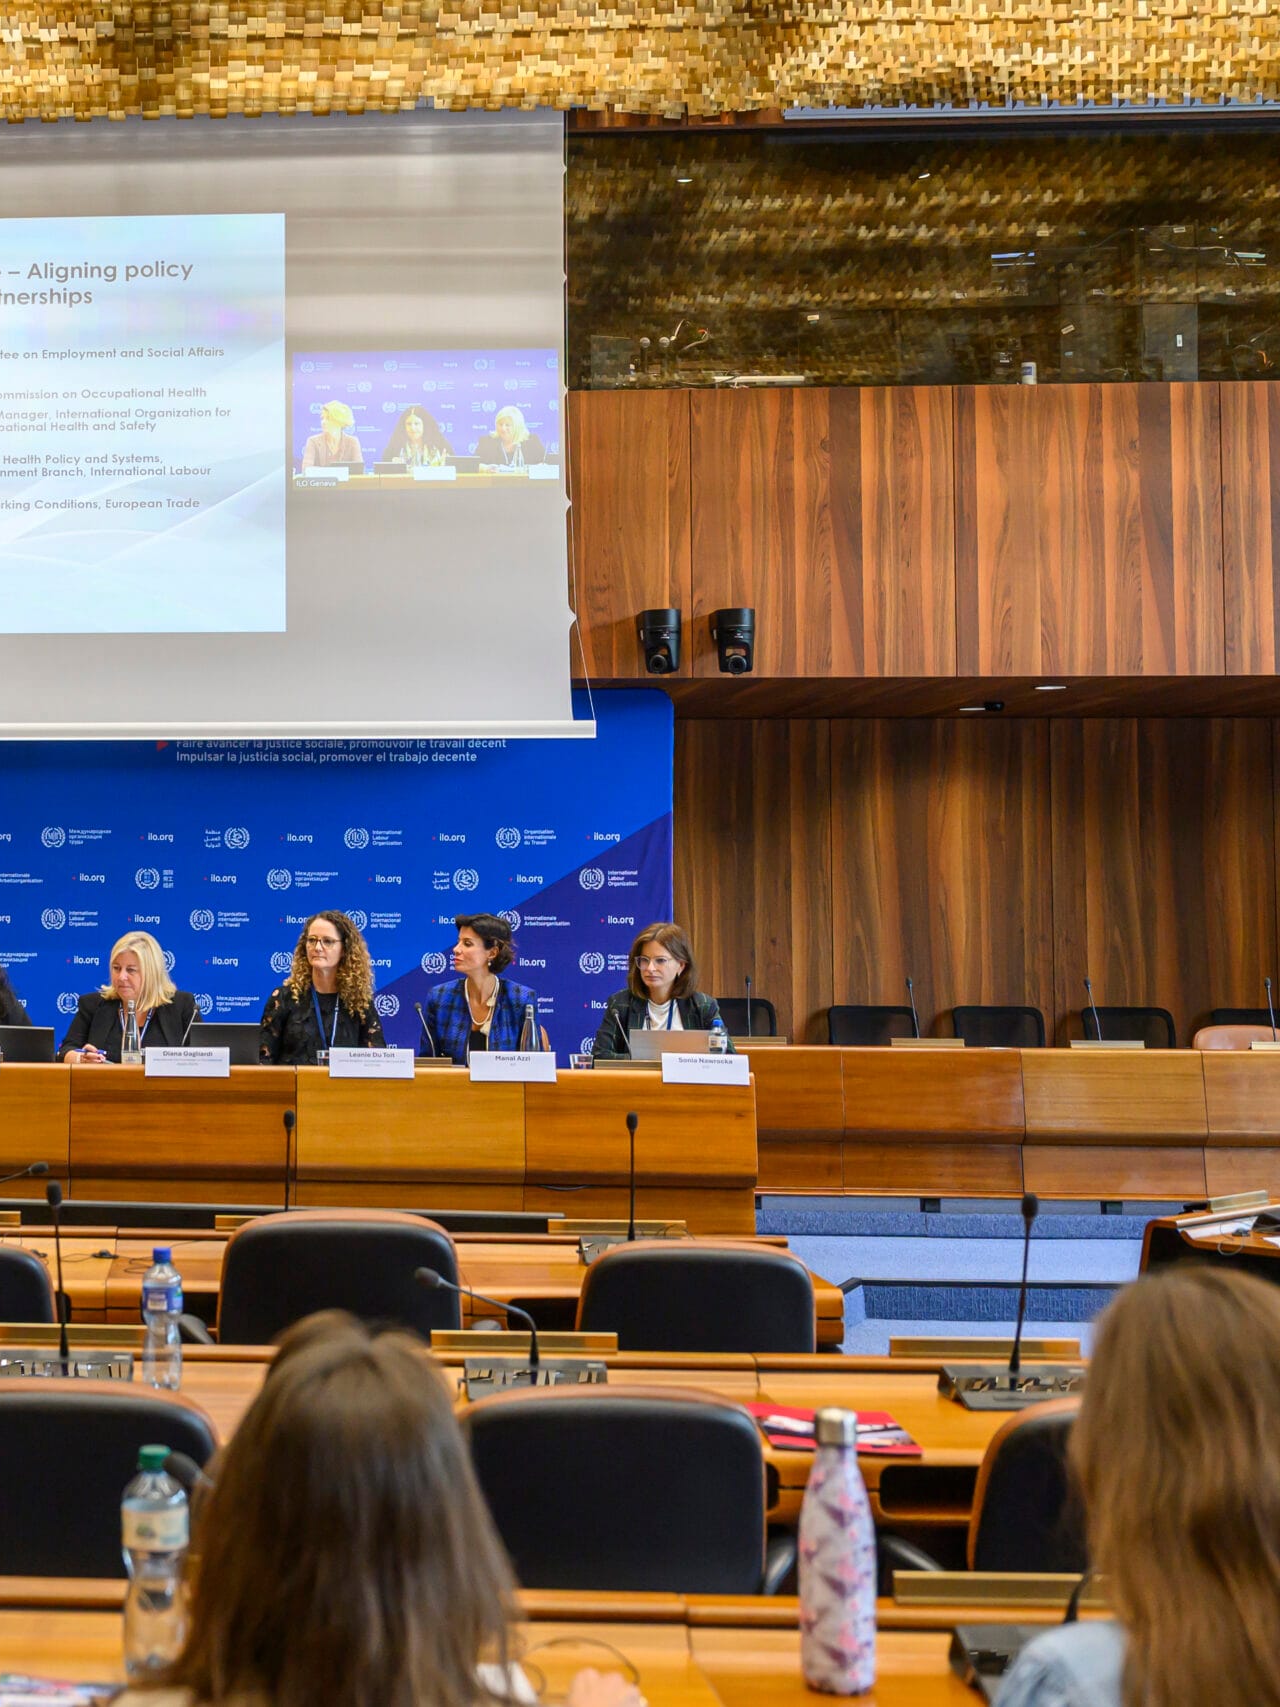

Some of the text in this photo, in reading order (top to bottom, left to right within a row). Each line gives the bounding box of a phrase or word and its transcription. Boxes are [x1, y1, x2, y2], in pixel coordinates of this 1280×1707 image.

[26, 262, 116, 284] Aligning
[125, 261, 193, 283] policy
[42, 348, 117, 362] Employment
[120, 348, 144, 359] and
[147, 347, 184, 358] Social
[188, 347, 225, 358] Affairs
[81, 387, 164, 401] Occupational
[168, 387, 207, 398] Health
[3, 454, 41, 465] Health
[45, 454, 81, 467] Policy
[84, 454, 108, 464] and
[112, 453, 163, 466] Systems,
[42, 466, 86, 479] Branch,
[90, 466, 166, 477] International
[170, 465, 212, 476] Labour
[34, 499, 101, 511] Conditions,
[105, 498, 163, 512] European
[166, 498, 200, 509] Trade
[177, 752, 477, 764] Impulsar la justicia social, promover el trabajo decente
[287, 834, 312, 843] ilo.org
[594, 833, 620, 842] ilo.org
[80, 874, 105, 883] ilo.org
[376, 874, 401, 884] ilo.org
[608, 916, 634, 925] ilo.org
[74, 956, 99, 965] ilo.org
